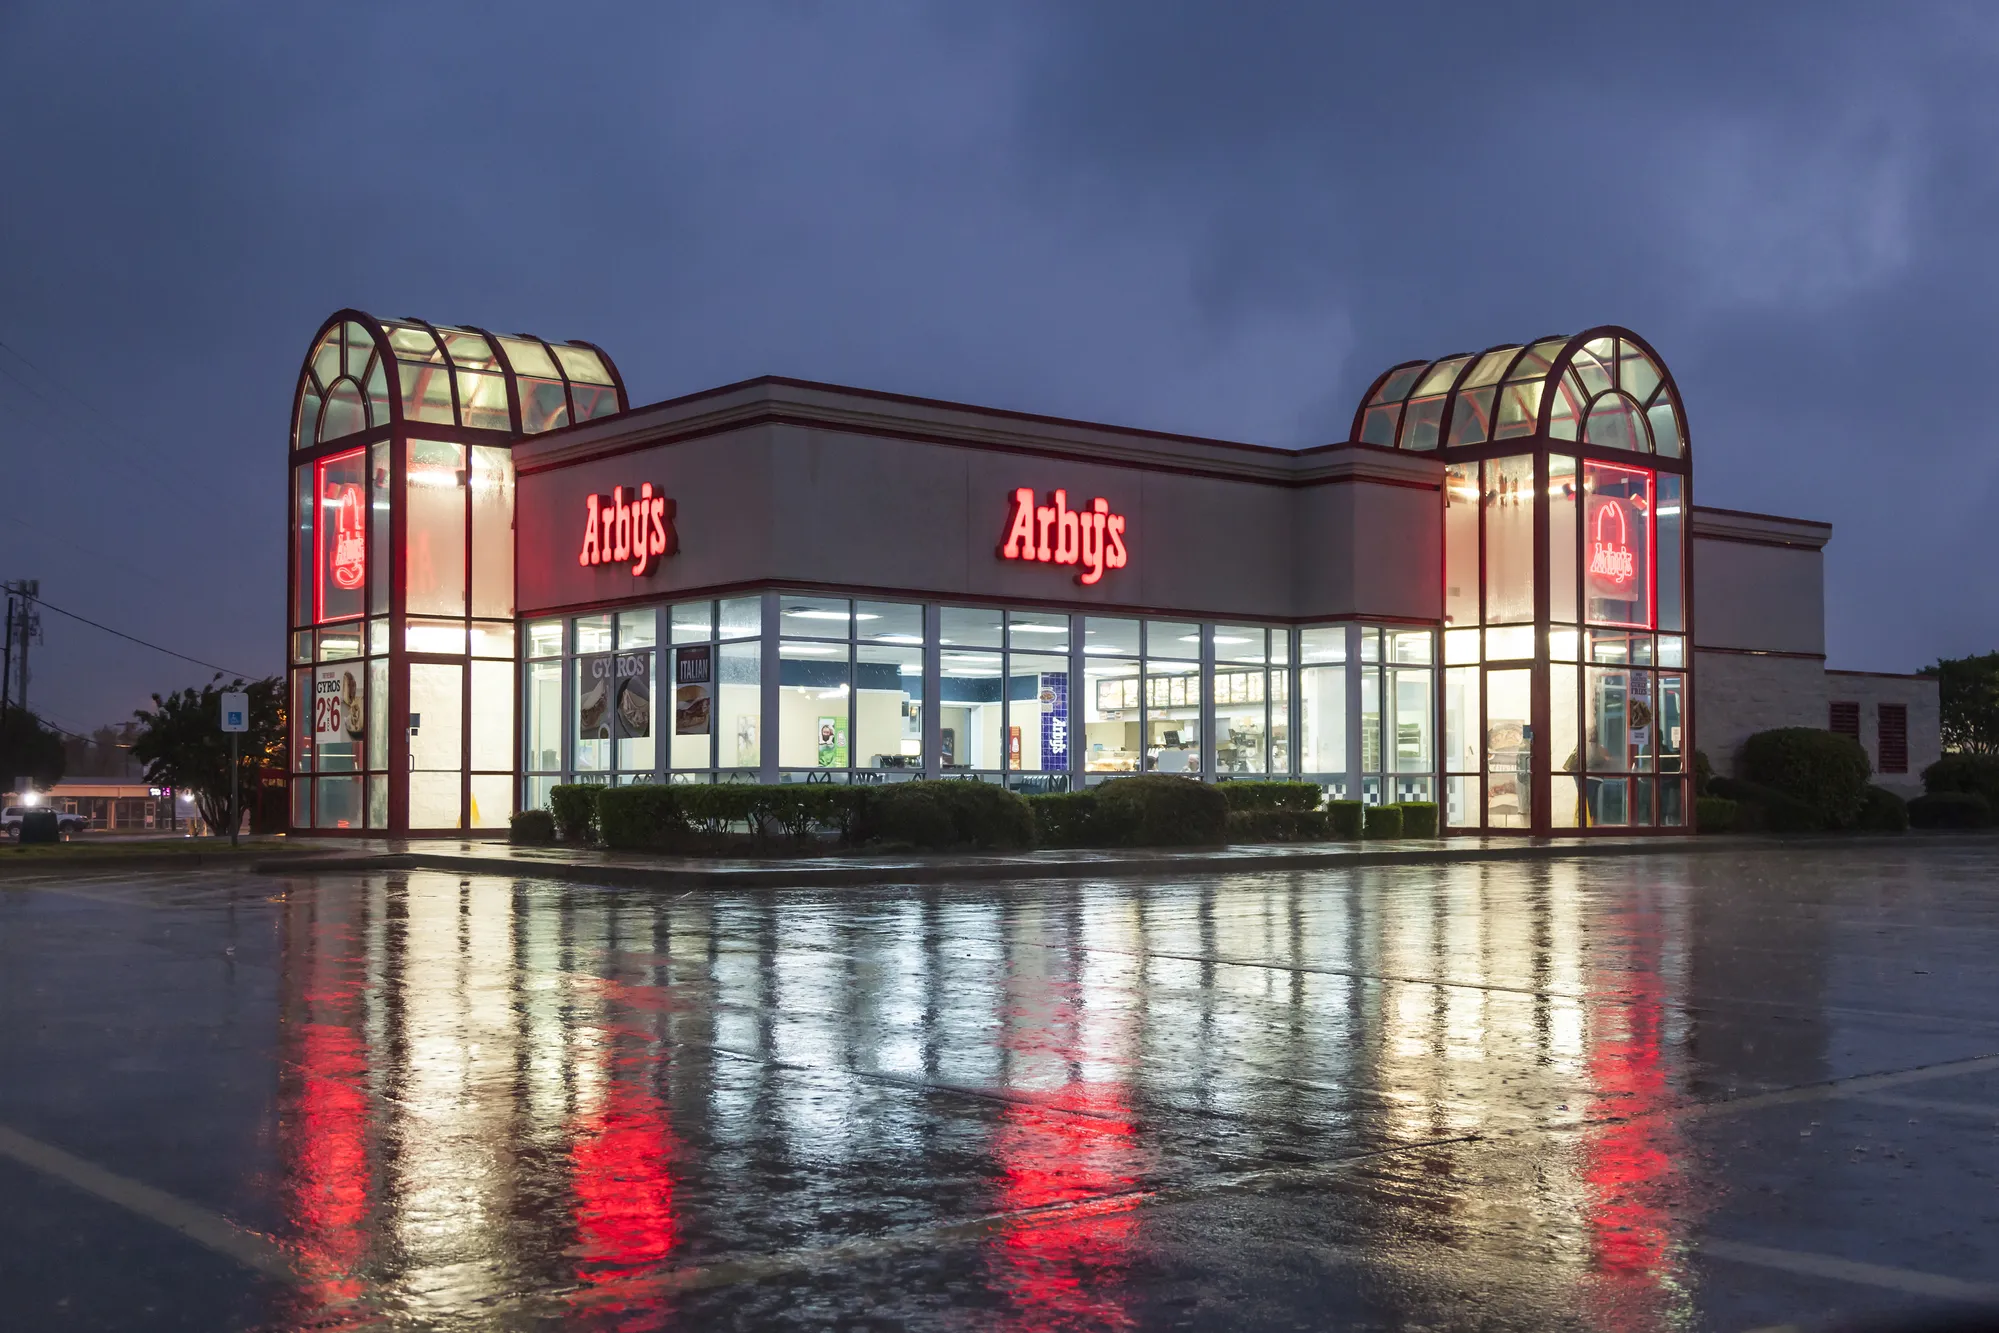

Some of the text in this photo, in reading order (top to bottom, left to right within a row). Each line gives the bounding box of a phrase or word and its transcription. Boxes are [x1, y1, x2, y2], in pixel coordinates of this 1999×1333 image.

[579, 481, 666, 577] Arby's
[1003, 487, 1127, 585] Arby's
[1590, 542, 1632, 584] Arby's
[316, 680, 341, 694] GYROS
[680, 659, 709, 680] ITALIAN
[316, 697, 326, 733] 2
[1049, 716, 1067, 754] Arby's
